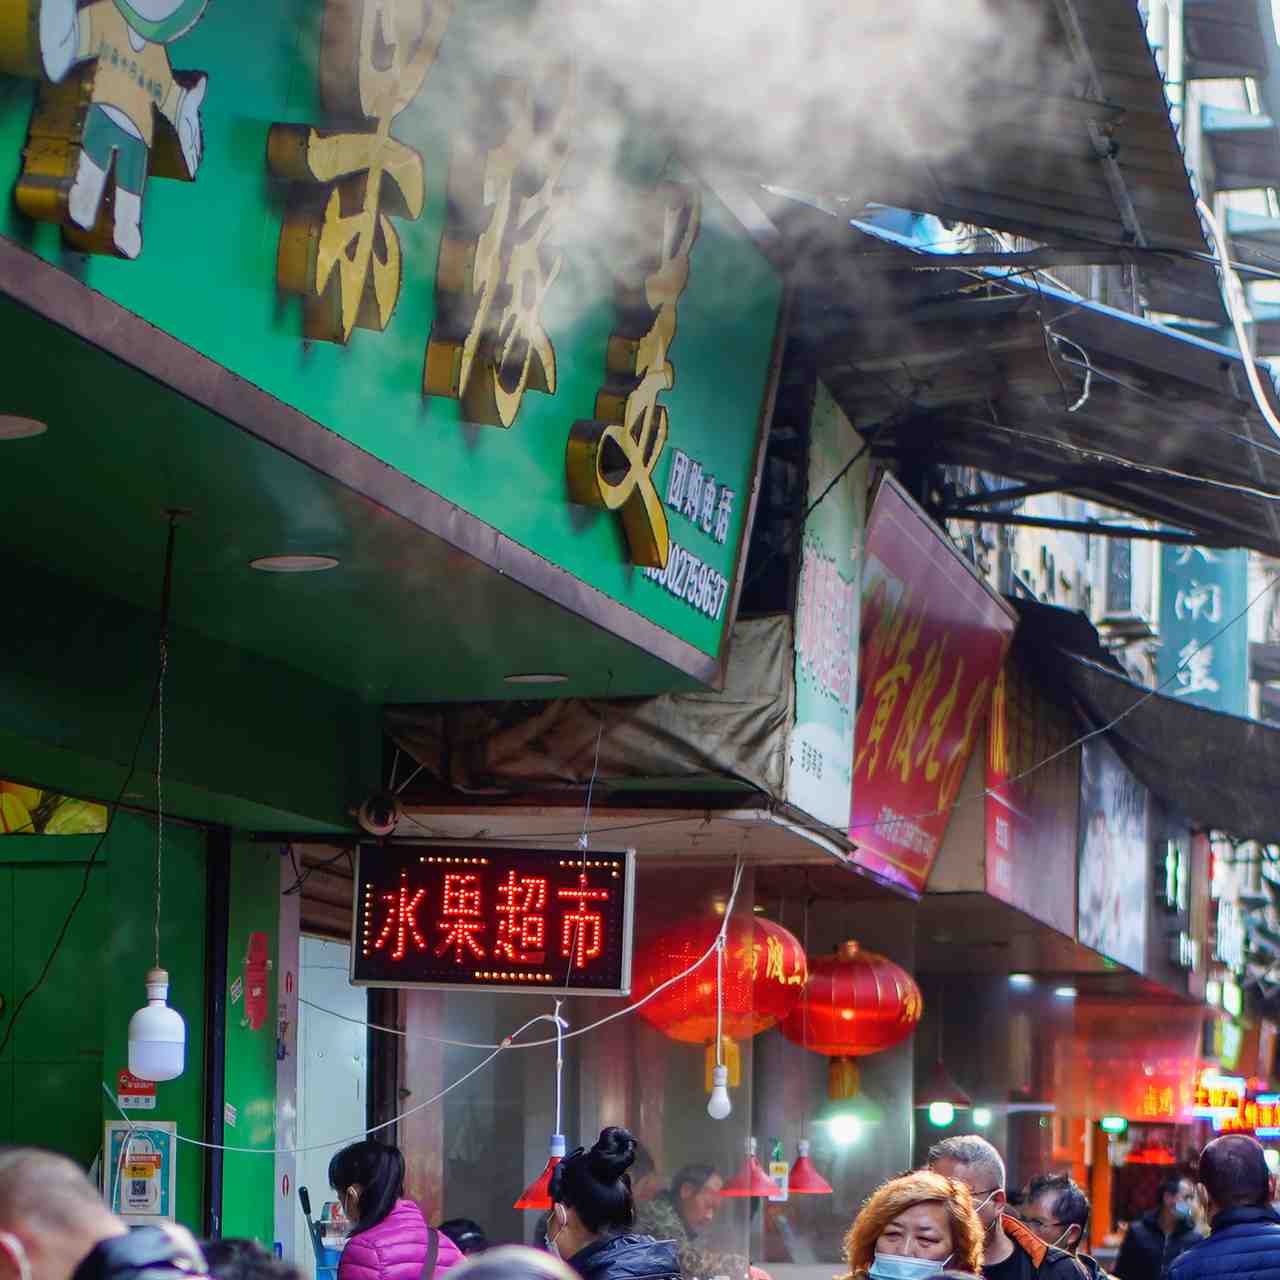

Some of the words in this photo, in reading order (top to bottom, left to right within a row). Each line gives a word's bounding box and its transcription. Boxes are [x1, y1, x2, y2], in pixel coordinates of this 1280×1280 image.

[668, 452, 736, 545] 团购电话
[642, 540, 729, 621] 02759637
[375, 870, 609, 968] 水果超市
